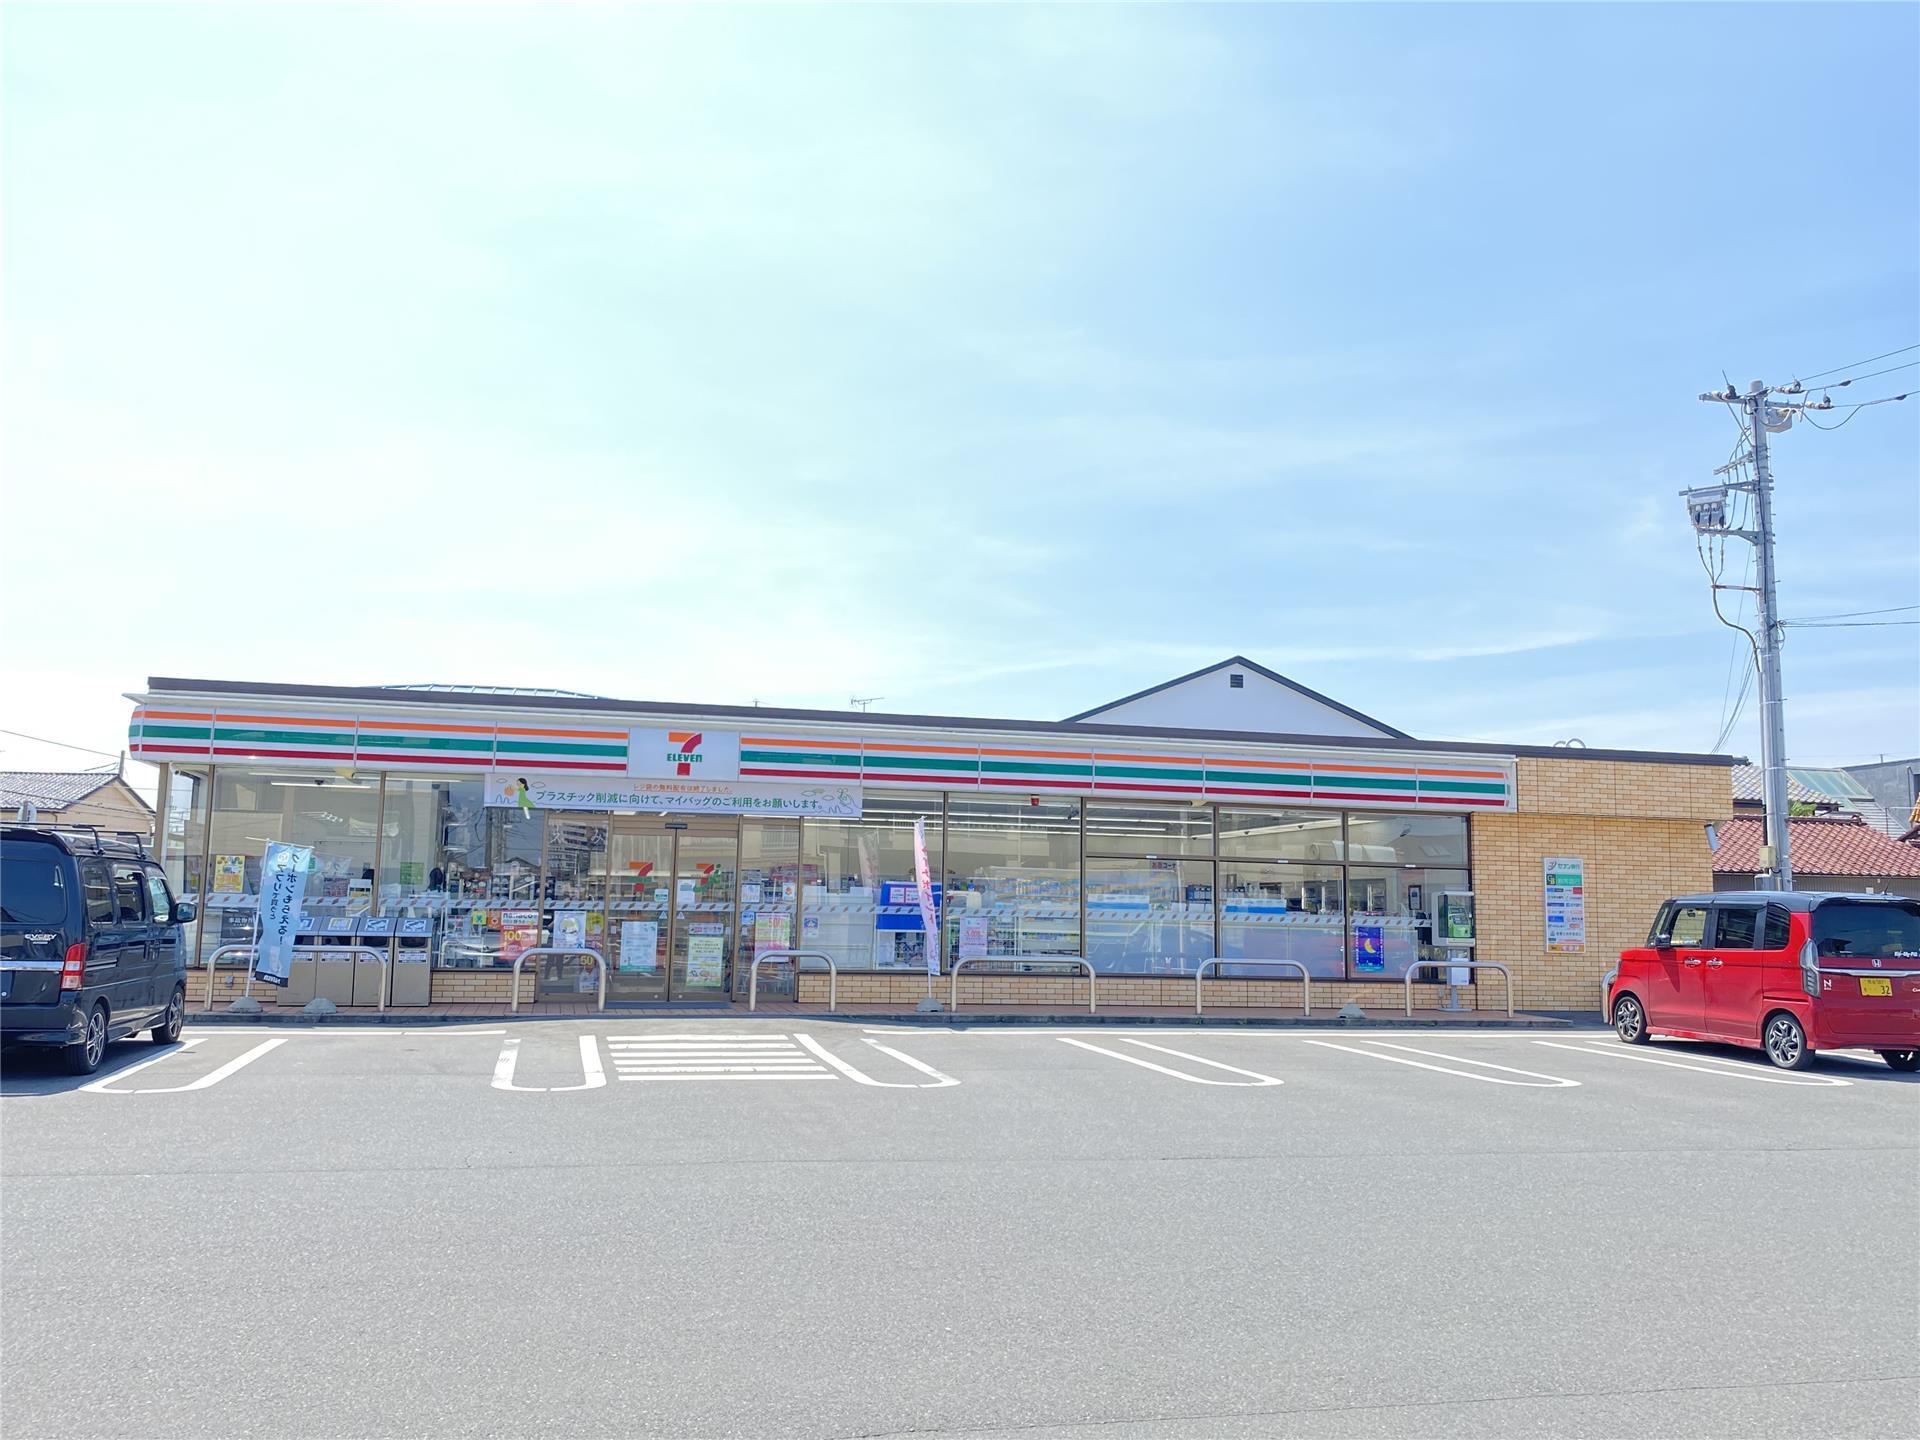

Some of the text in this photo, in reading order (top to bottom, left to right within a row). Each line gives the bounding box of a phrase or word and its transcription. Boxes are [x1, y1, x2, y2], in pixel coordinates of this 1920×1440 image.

[536, 790, 823, 810] プラスチック削減に向けて、マイバッグのご利用をお願いします。
